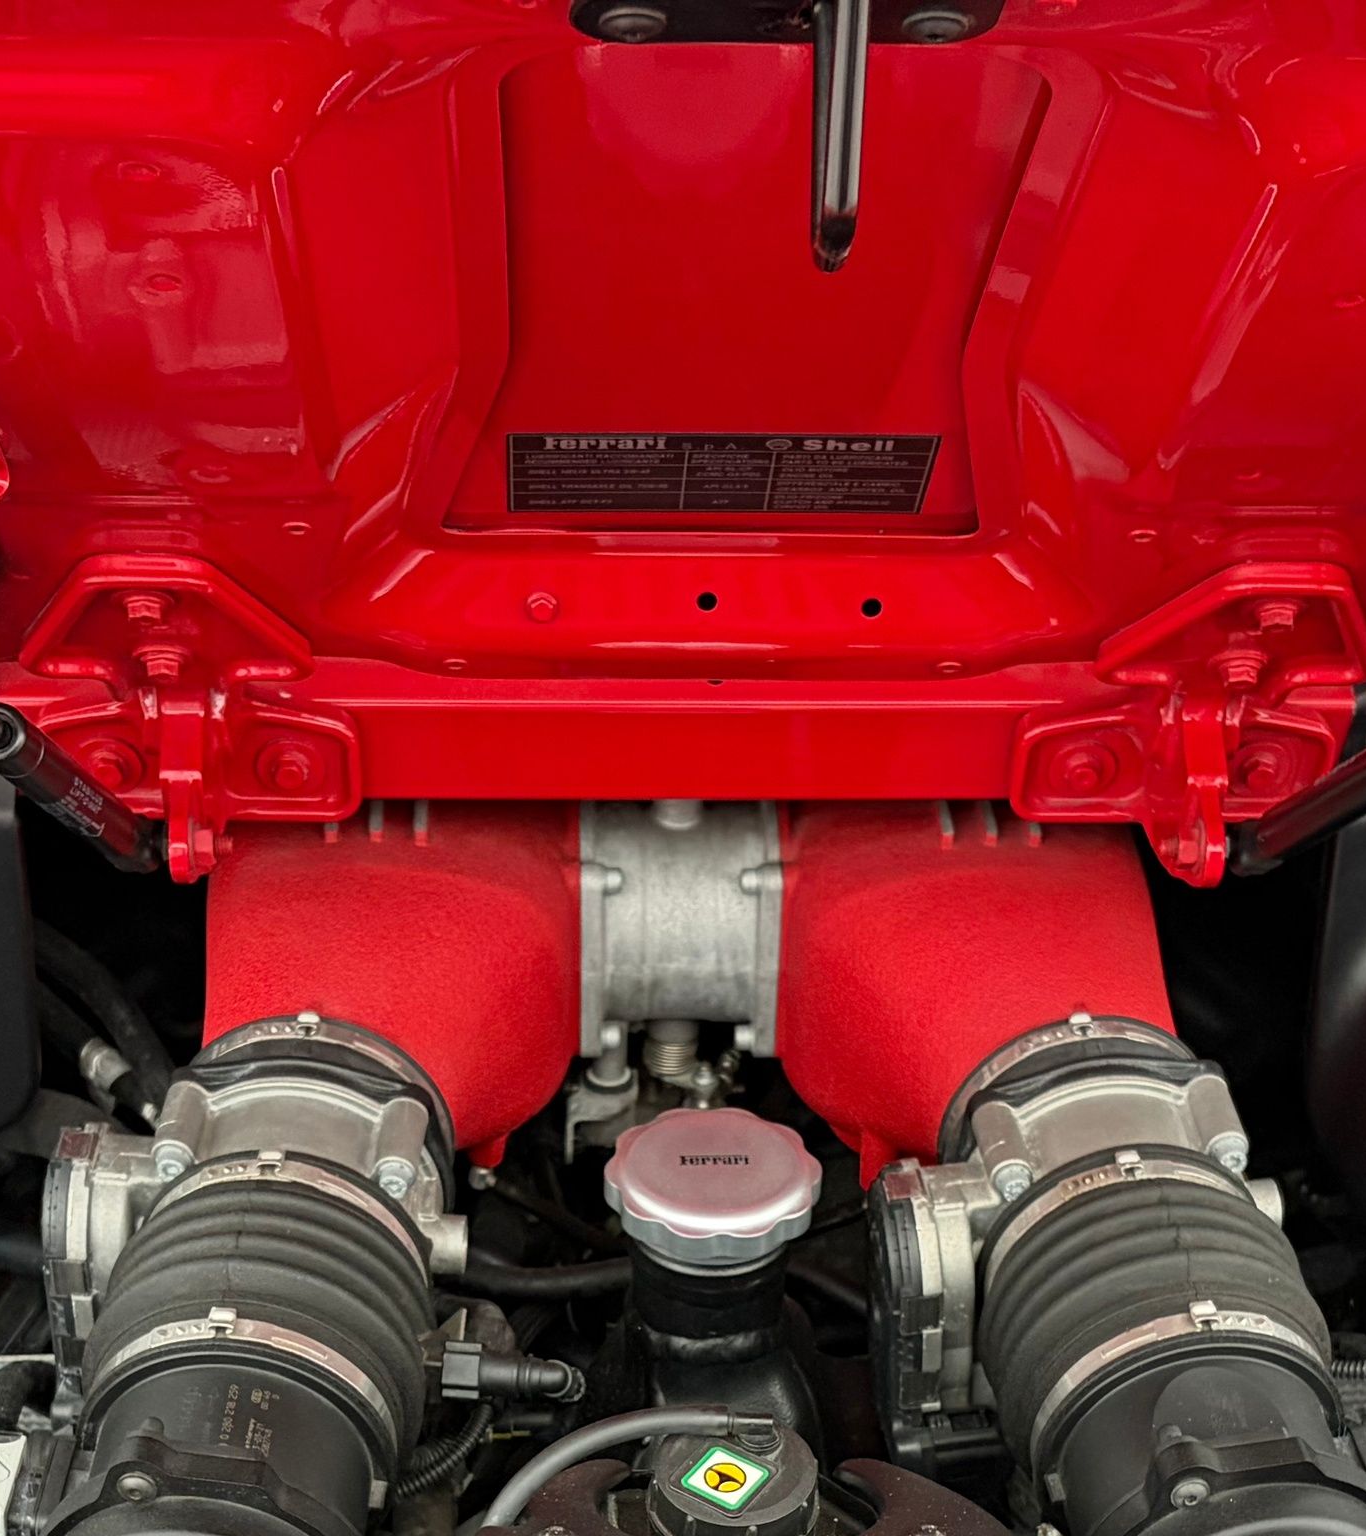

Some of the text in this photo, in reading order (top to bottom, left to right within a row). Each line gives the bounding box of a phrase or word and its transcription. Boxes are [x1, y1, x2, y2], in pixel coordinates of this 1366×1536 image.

[543, 436, 668, 450] Ferrari
[803, 439, 894, 452] Shell
[679, 1155, 749, 1166] Ferrari
